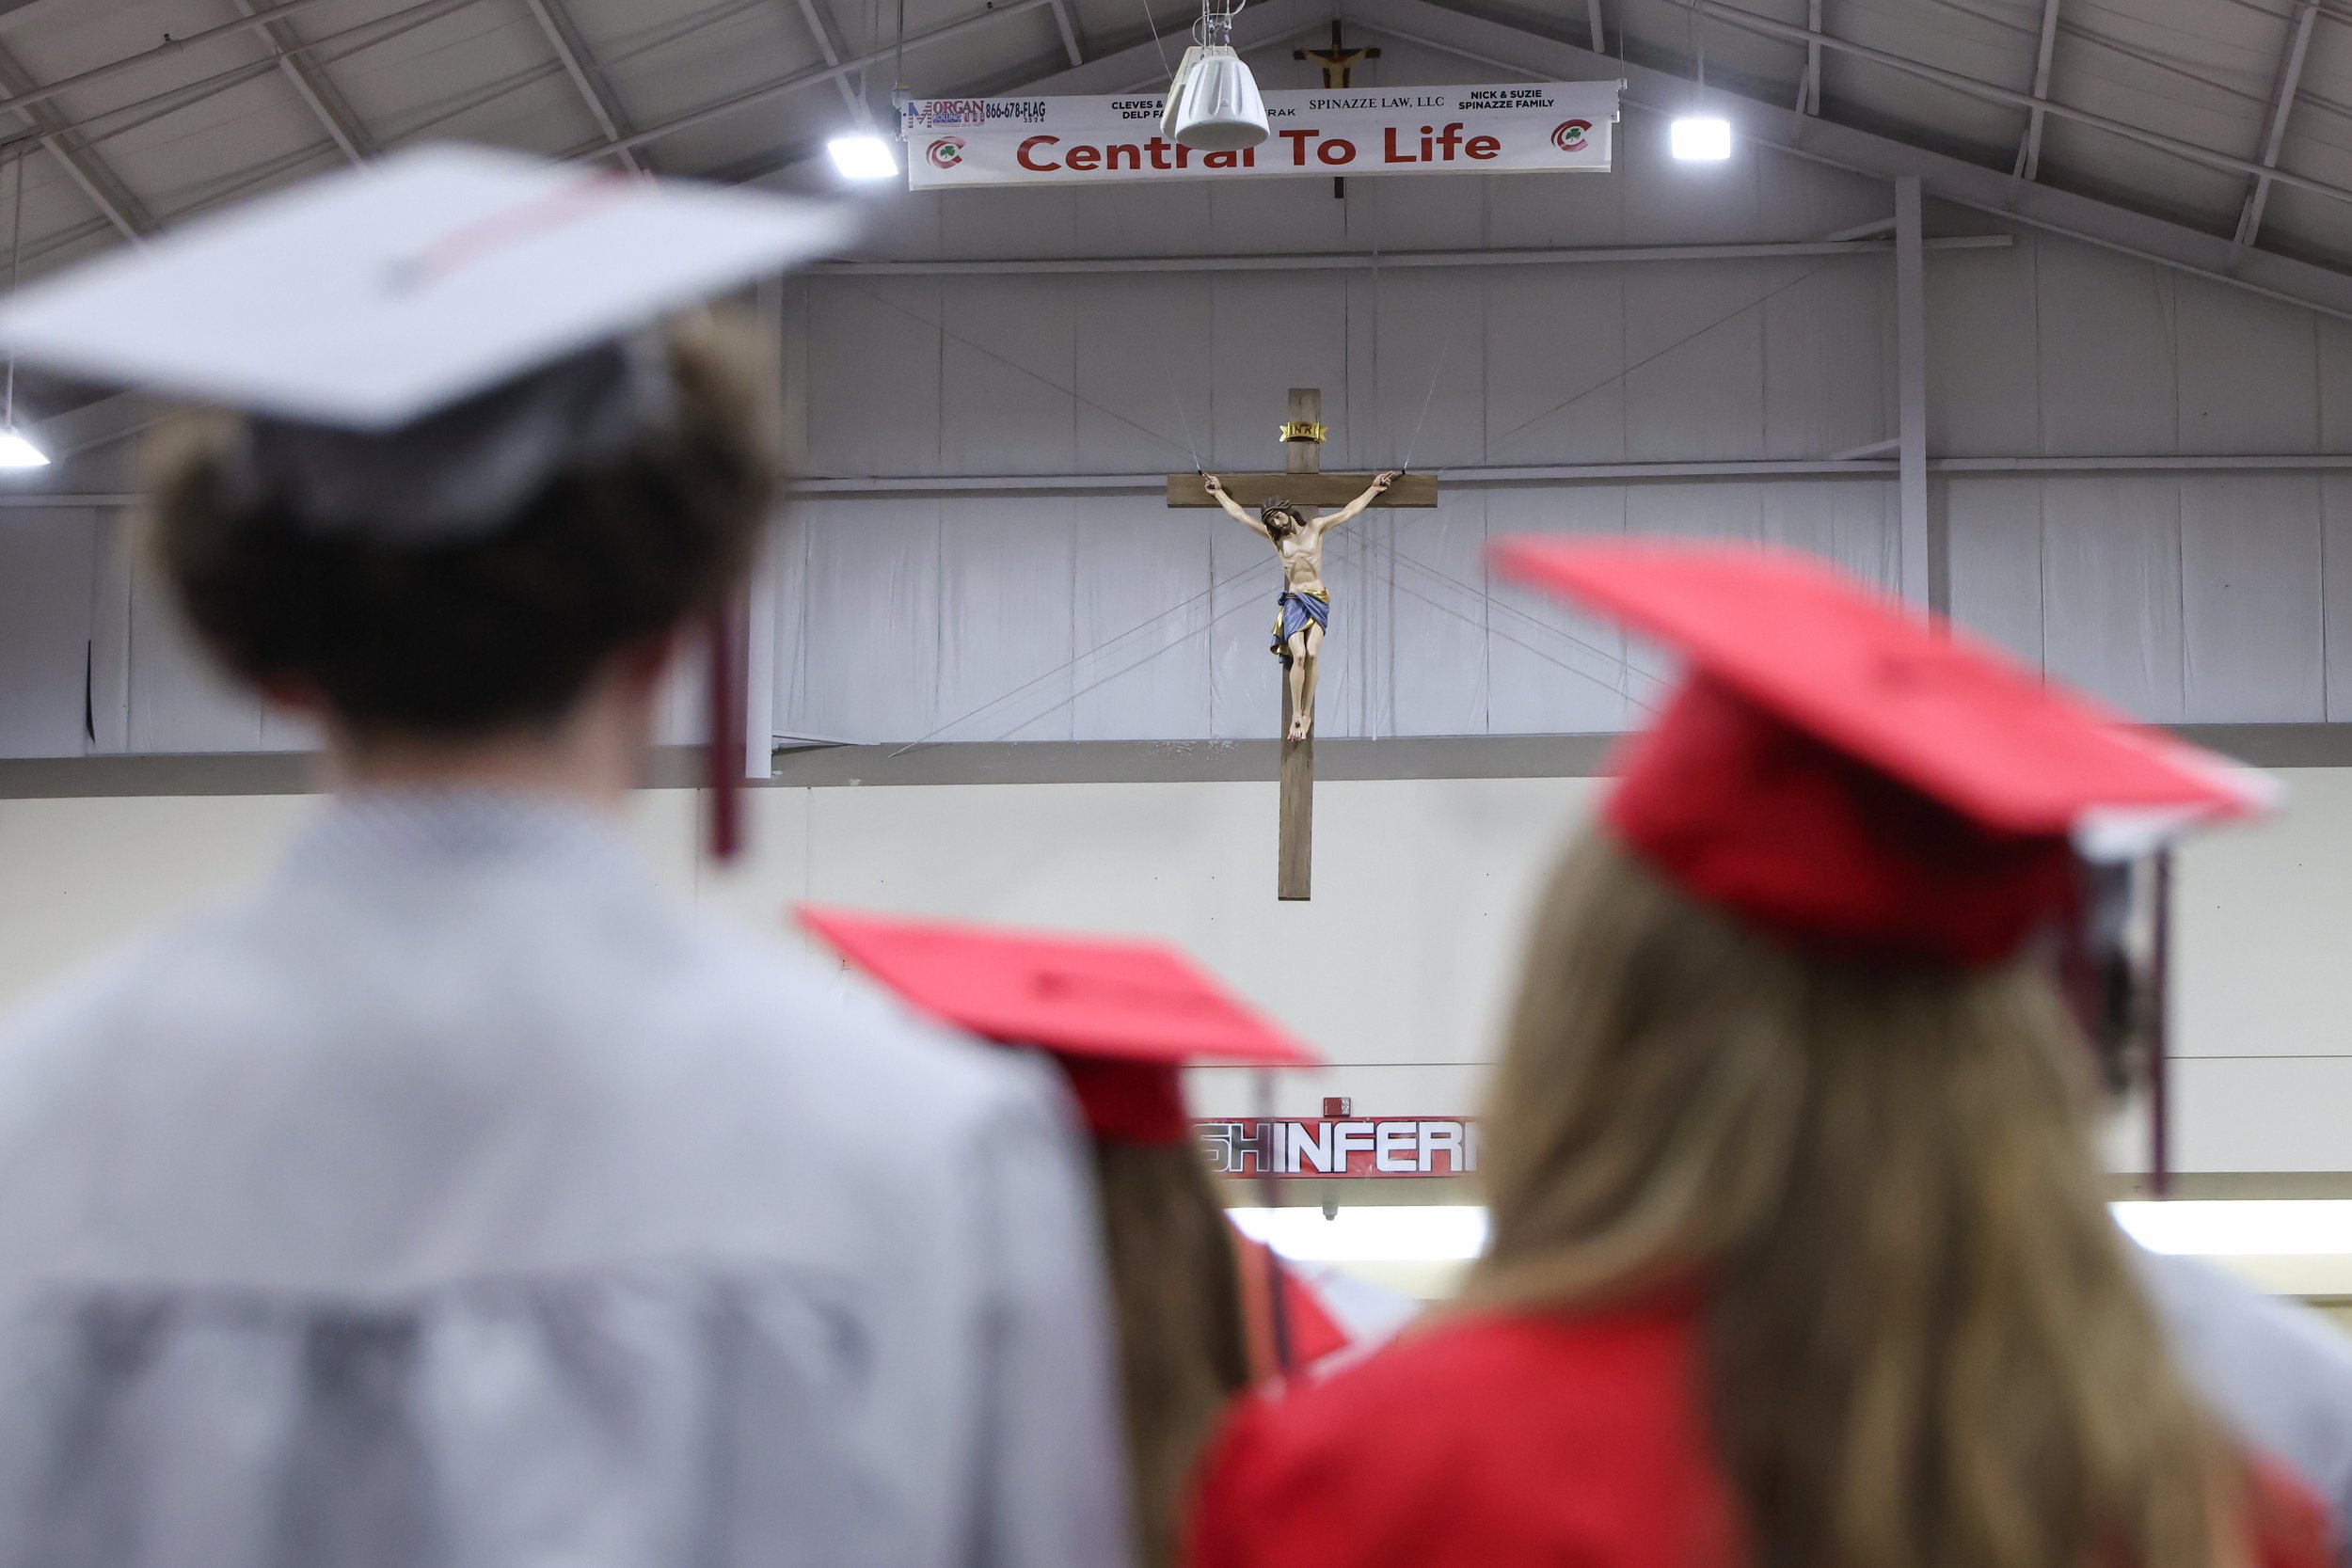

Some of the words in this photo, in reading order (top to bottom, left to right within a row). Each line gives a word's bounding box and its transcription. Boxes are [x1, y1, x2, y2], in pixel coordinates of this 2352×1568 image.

[1470, 90, 1498, 100] NICK
[1500, 90, 1507, 99] &
[1510, 89, 1543, 99] SUZIE
[1111, 101, 1153, 110] CLEVES
[1155, 100, 1164, 109] &
[1309, 98, 1377, 110] SPINAZZE
[1381, 97, 1413, 109] LAW,
[1417, 96, 1445, 107] LLC
[1458, 100, 1514, 110] SPINAZZE
[1516, 99, 1555, 108] FAMILY
[986, 102, 1046, 119] 866-678-FLAG
[1122, 110, 1151, 119] DELP
[1264, 108, 1296, 117] RAK
[1279, 129, 1357, 166] To
[1384, 122, 1502, 164] Life
